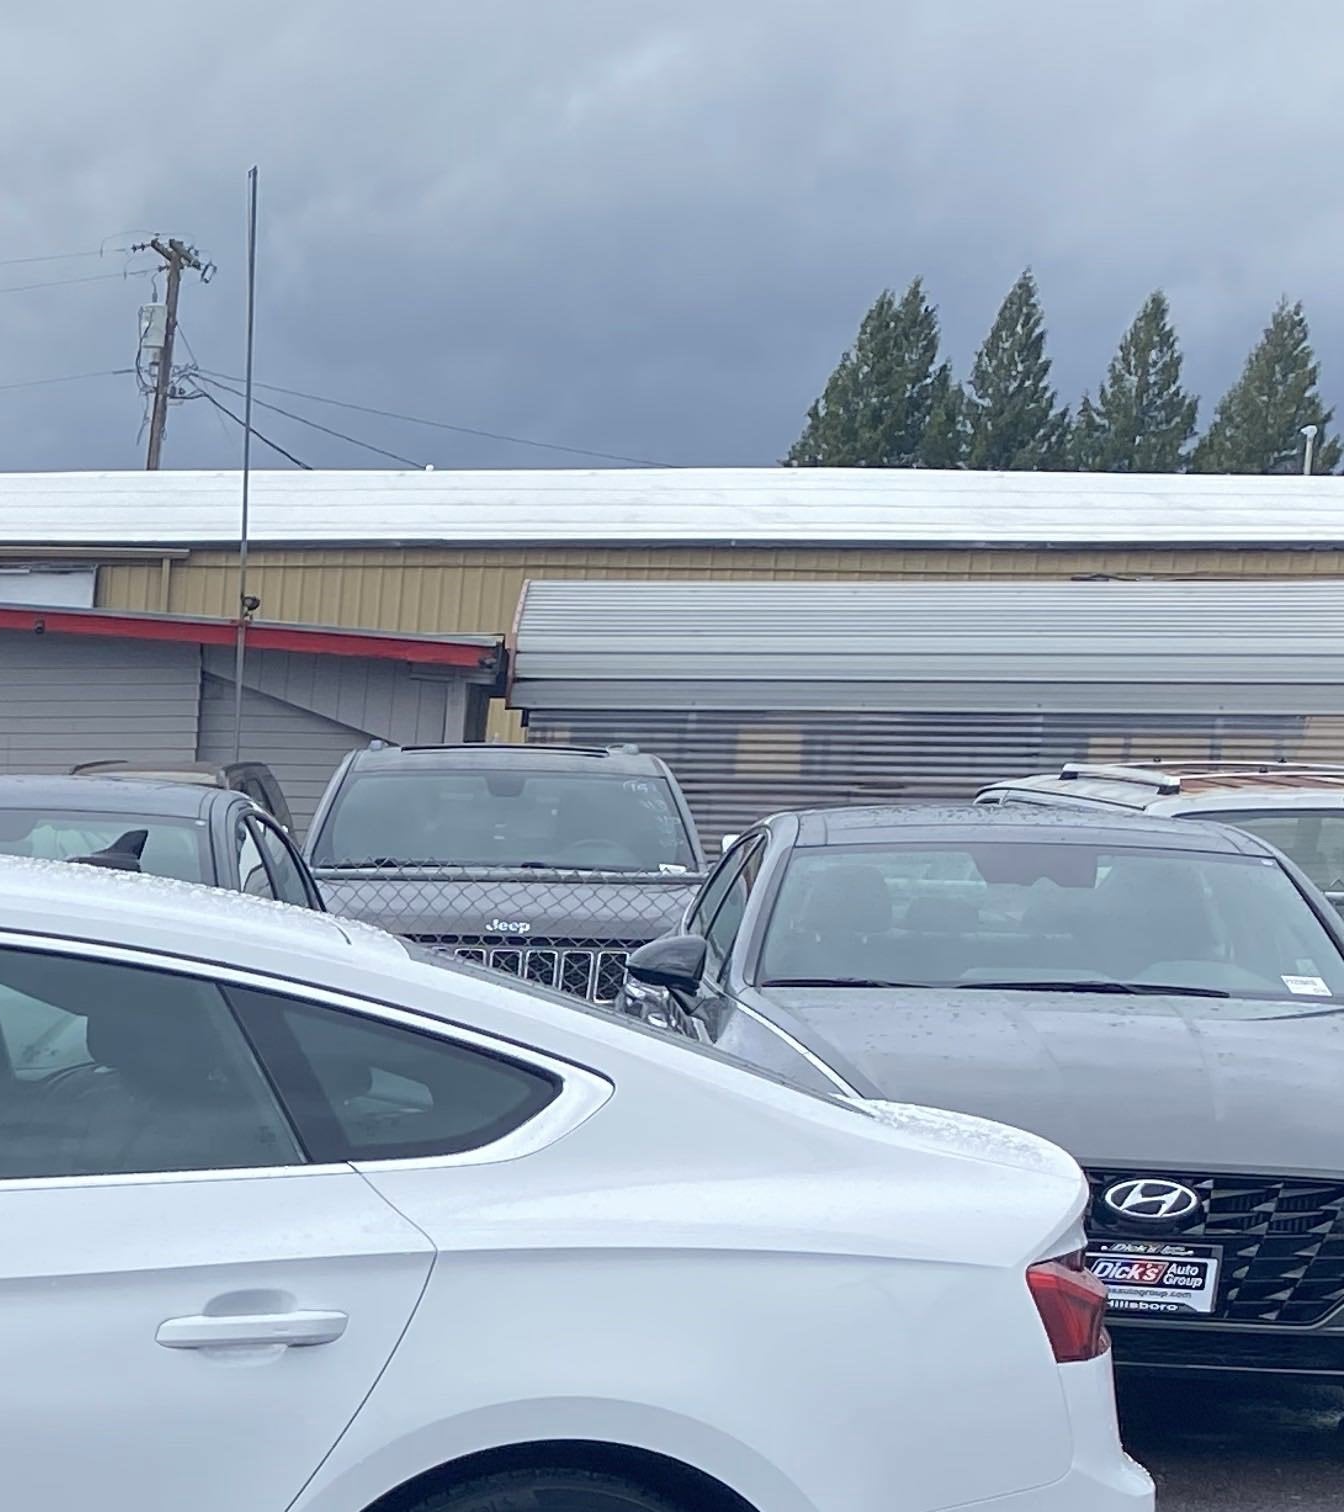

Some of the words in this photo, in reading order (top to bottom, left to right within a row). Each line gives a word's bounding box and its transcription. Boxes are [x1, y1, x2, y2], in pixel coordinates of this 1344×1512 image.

[485, 919, 530, 934] Jeep
[1093, 1261, 1159, 1281] Dick's
[1167, 1262, 1199, 1276] Auto
[1163, 1273, 1203, 1288] Group
